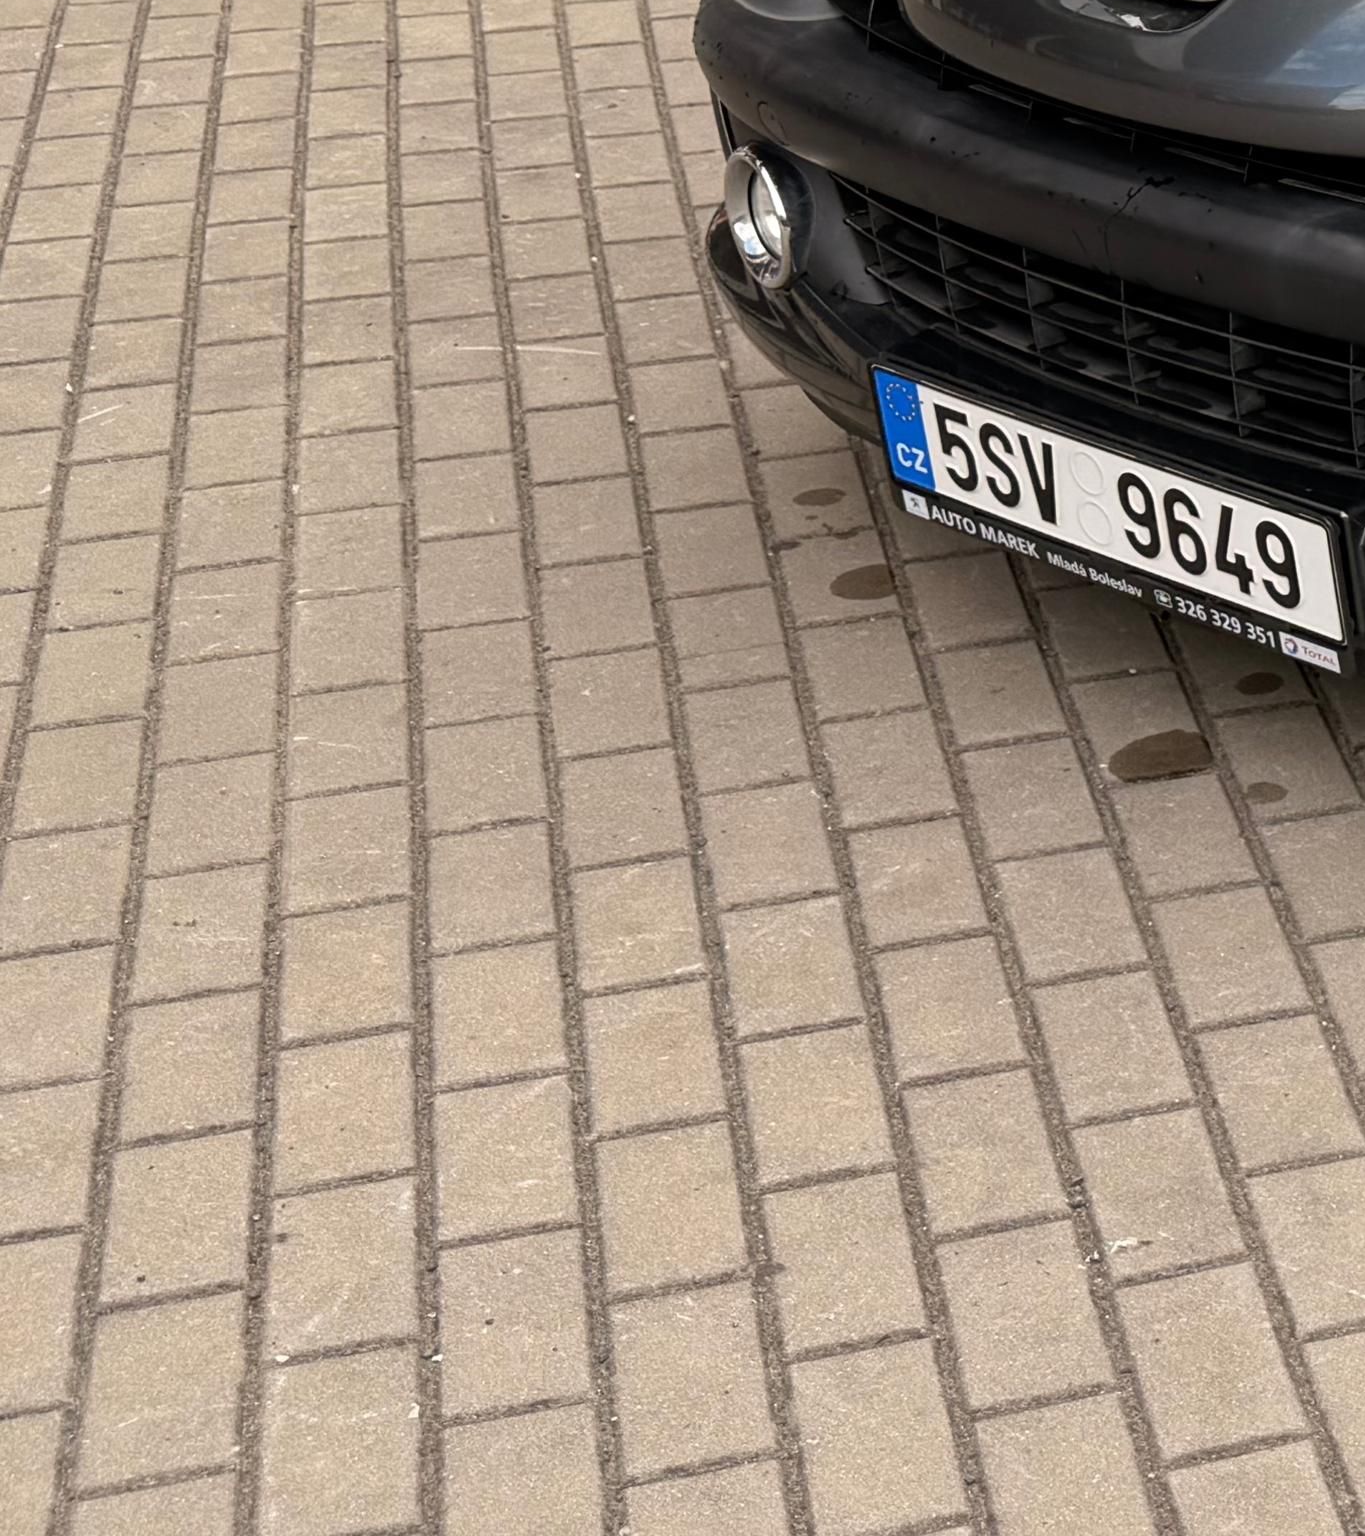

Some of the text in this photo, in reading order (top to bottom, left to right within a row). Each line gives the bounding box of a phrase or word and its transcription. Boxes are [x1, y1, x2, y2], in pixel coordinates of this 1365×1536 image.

[896, 443, 928, 474] CZ
[933, 403, 1302, 609] 5SV 9649
[931, 504, 1276, 649] AUTO MAREK Mladá Boleslav 326 329 351
[1301, 646, 1337, 666] TOTAL
